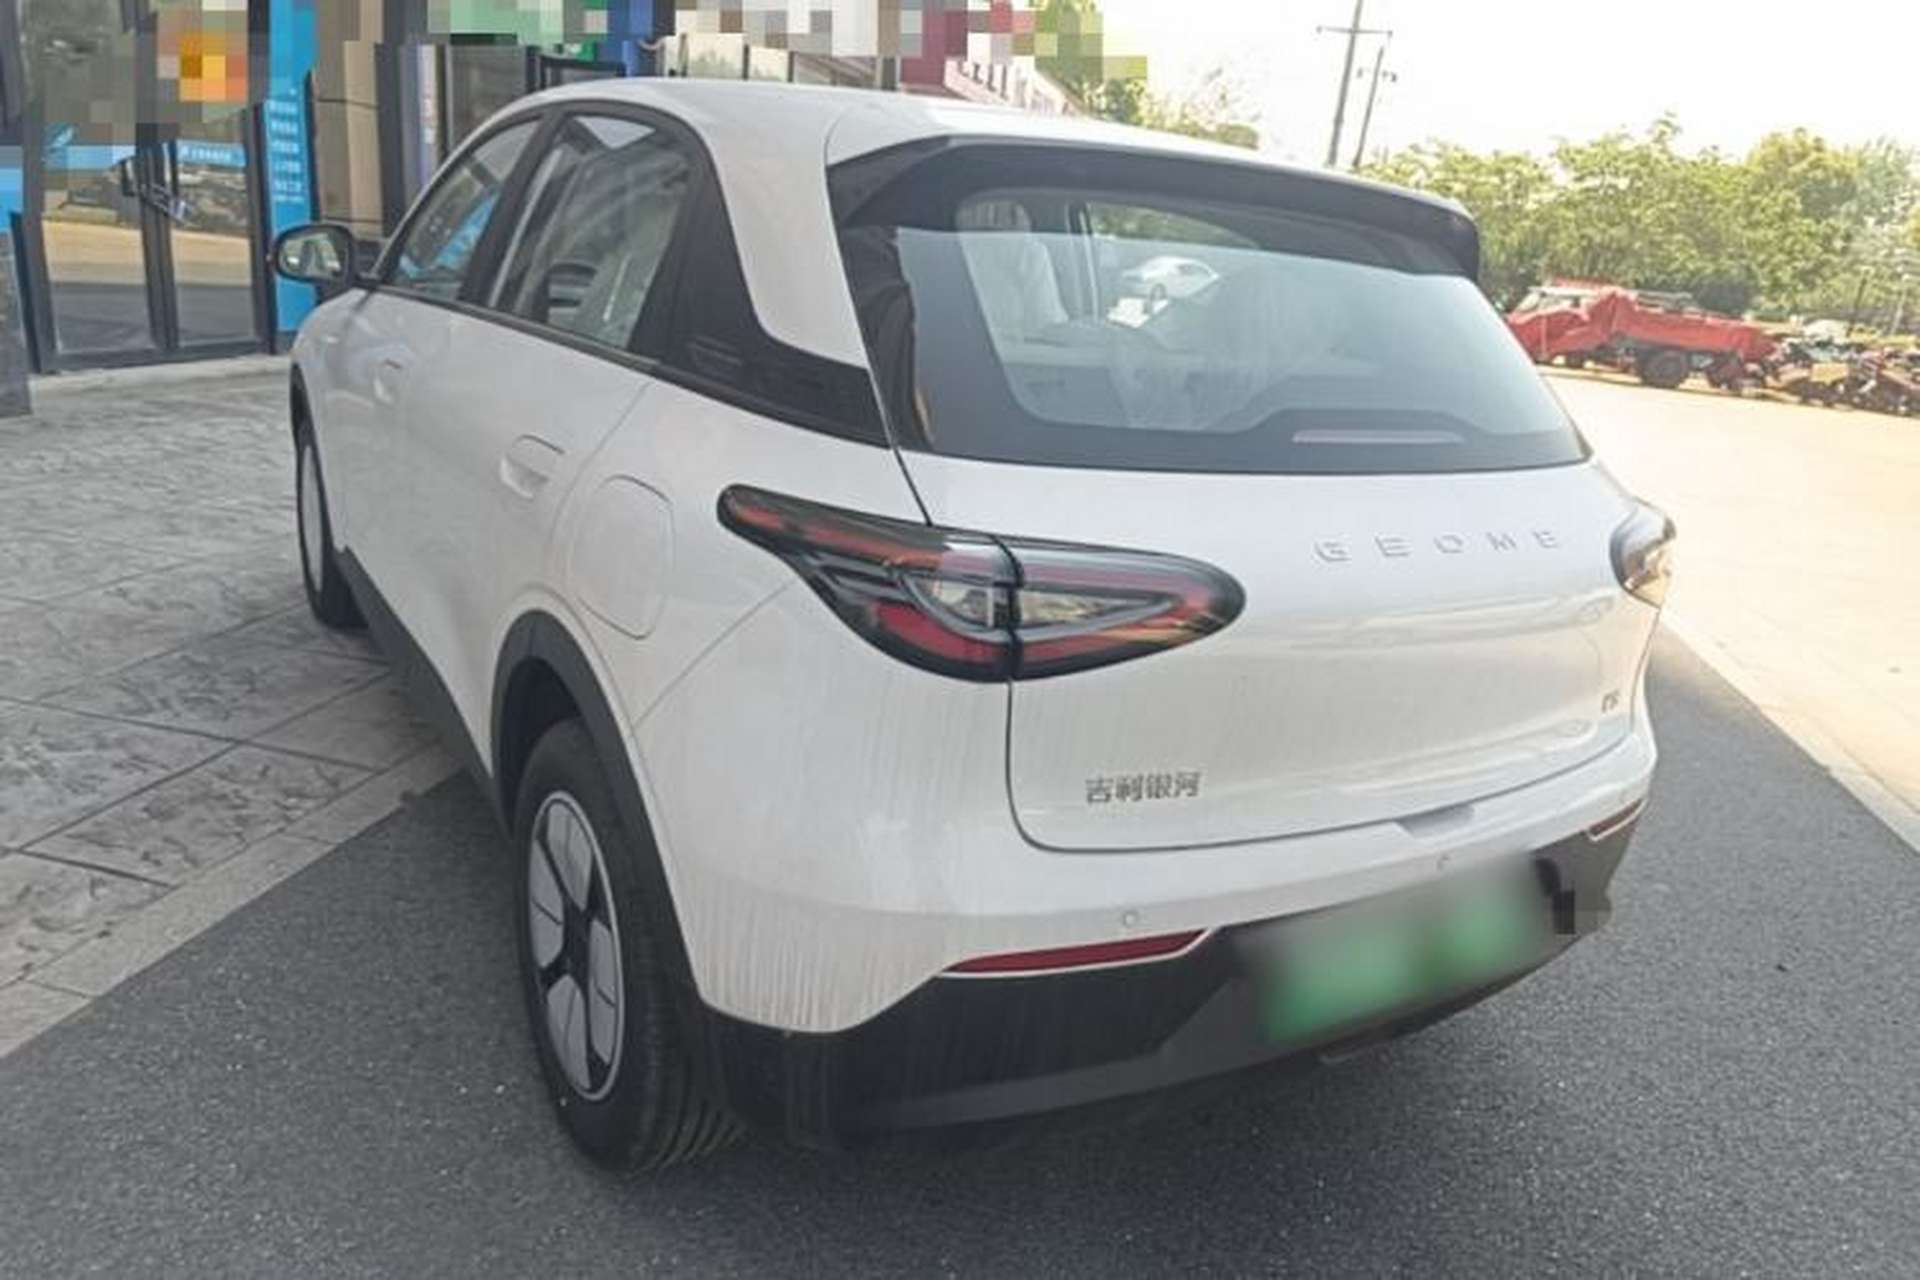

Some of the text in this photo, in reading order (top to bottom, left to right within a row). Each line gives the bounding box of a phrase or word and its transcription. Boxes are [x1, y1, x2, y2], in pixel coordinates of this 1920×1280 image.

[1314, 530, 1559, 563] GEOME
[1085, 771, 1201, 804] 吉利银河
